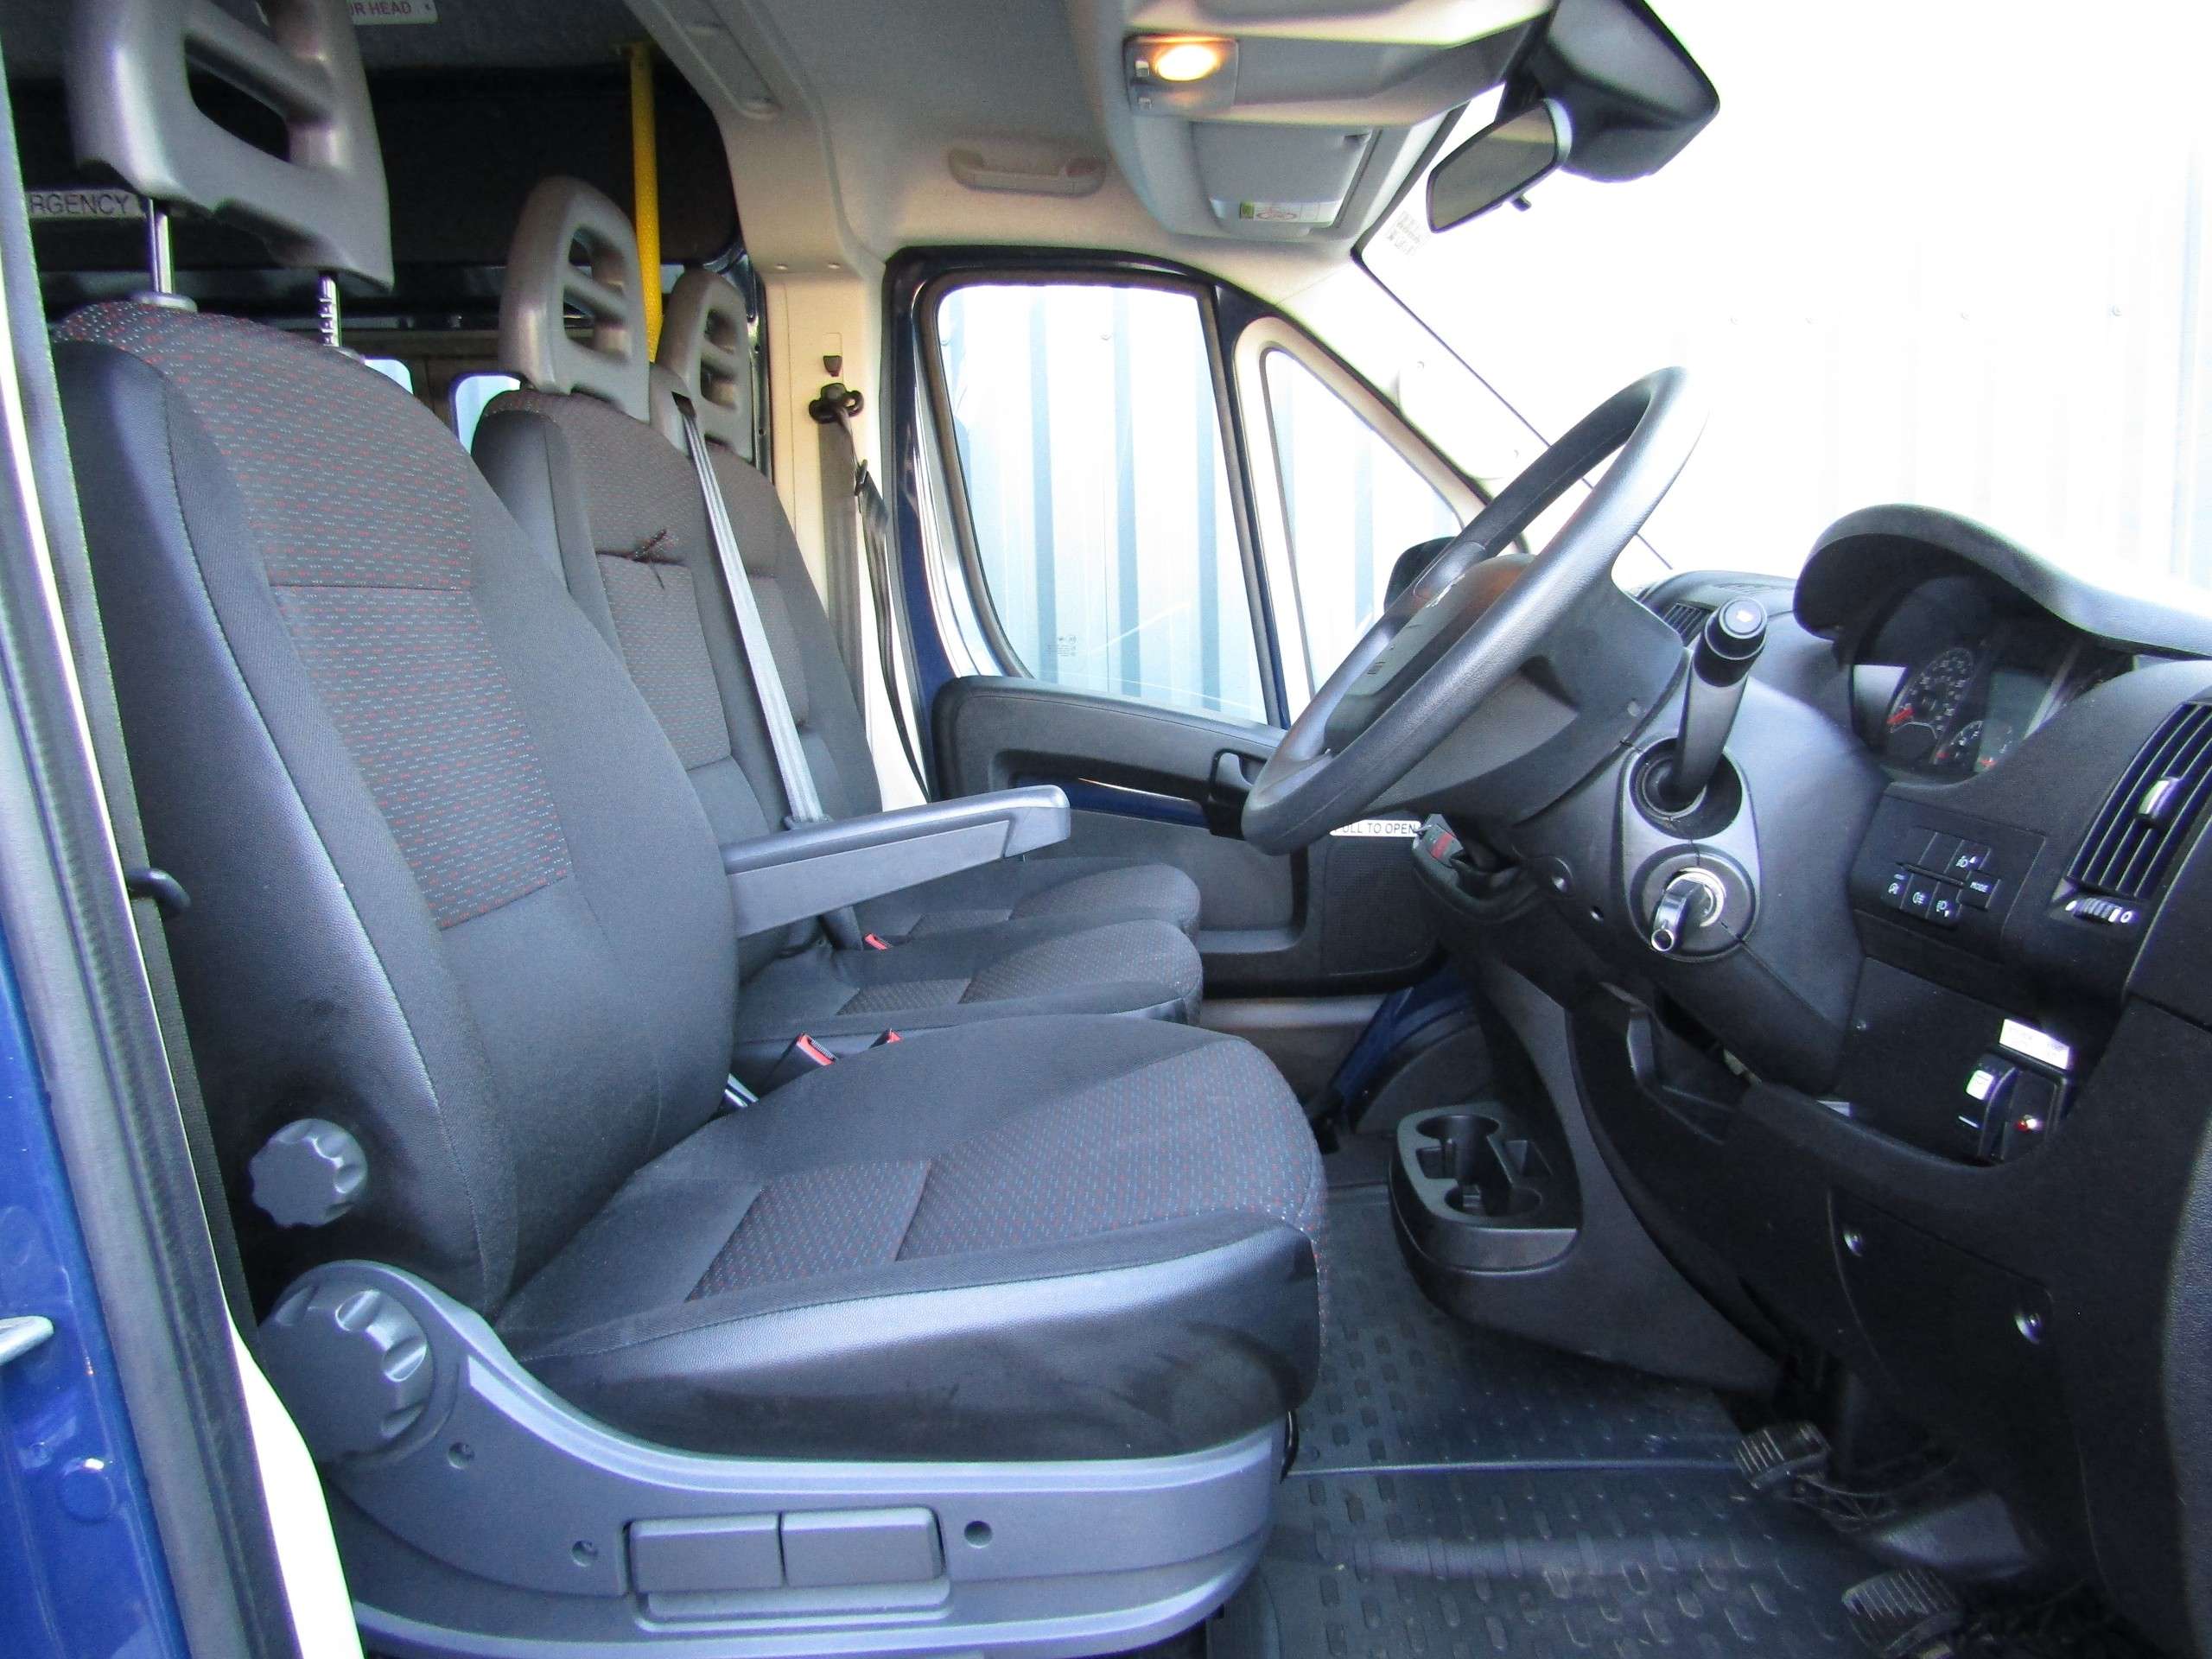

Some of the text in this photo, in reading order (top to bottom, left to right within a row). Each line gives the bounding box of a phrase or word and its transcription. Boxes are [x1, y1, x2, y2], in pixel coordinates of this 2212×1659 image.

[370, 1, 411, 15] HEAD
[1334, 823, 1417, 835] ULL TO OPEN
